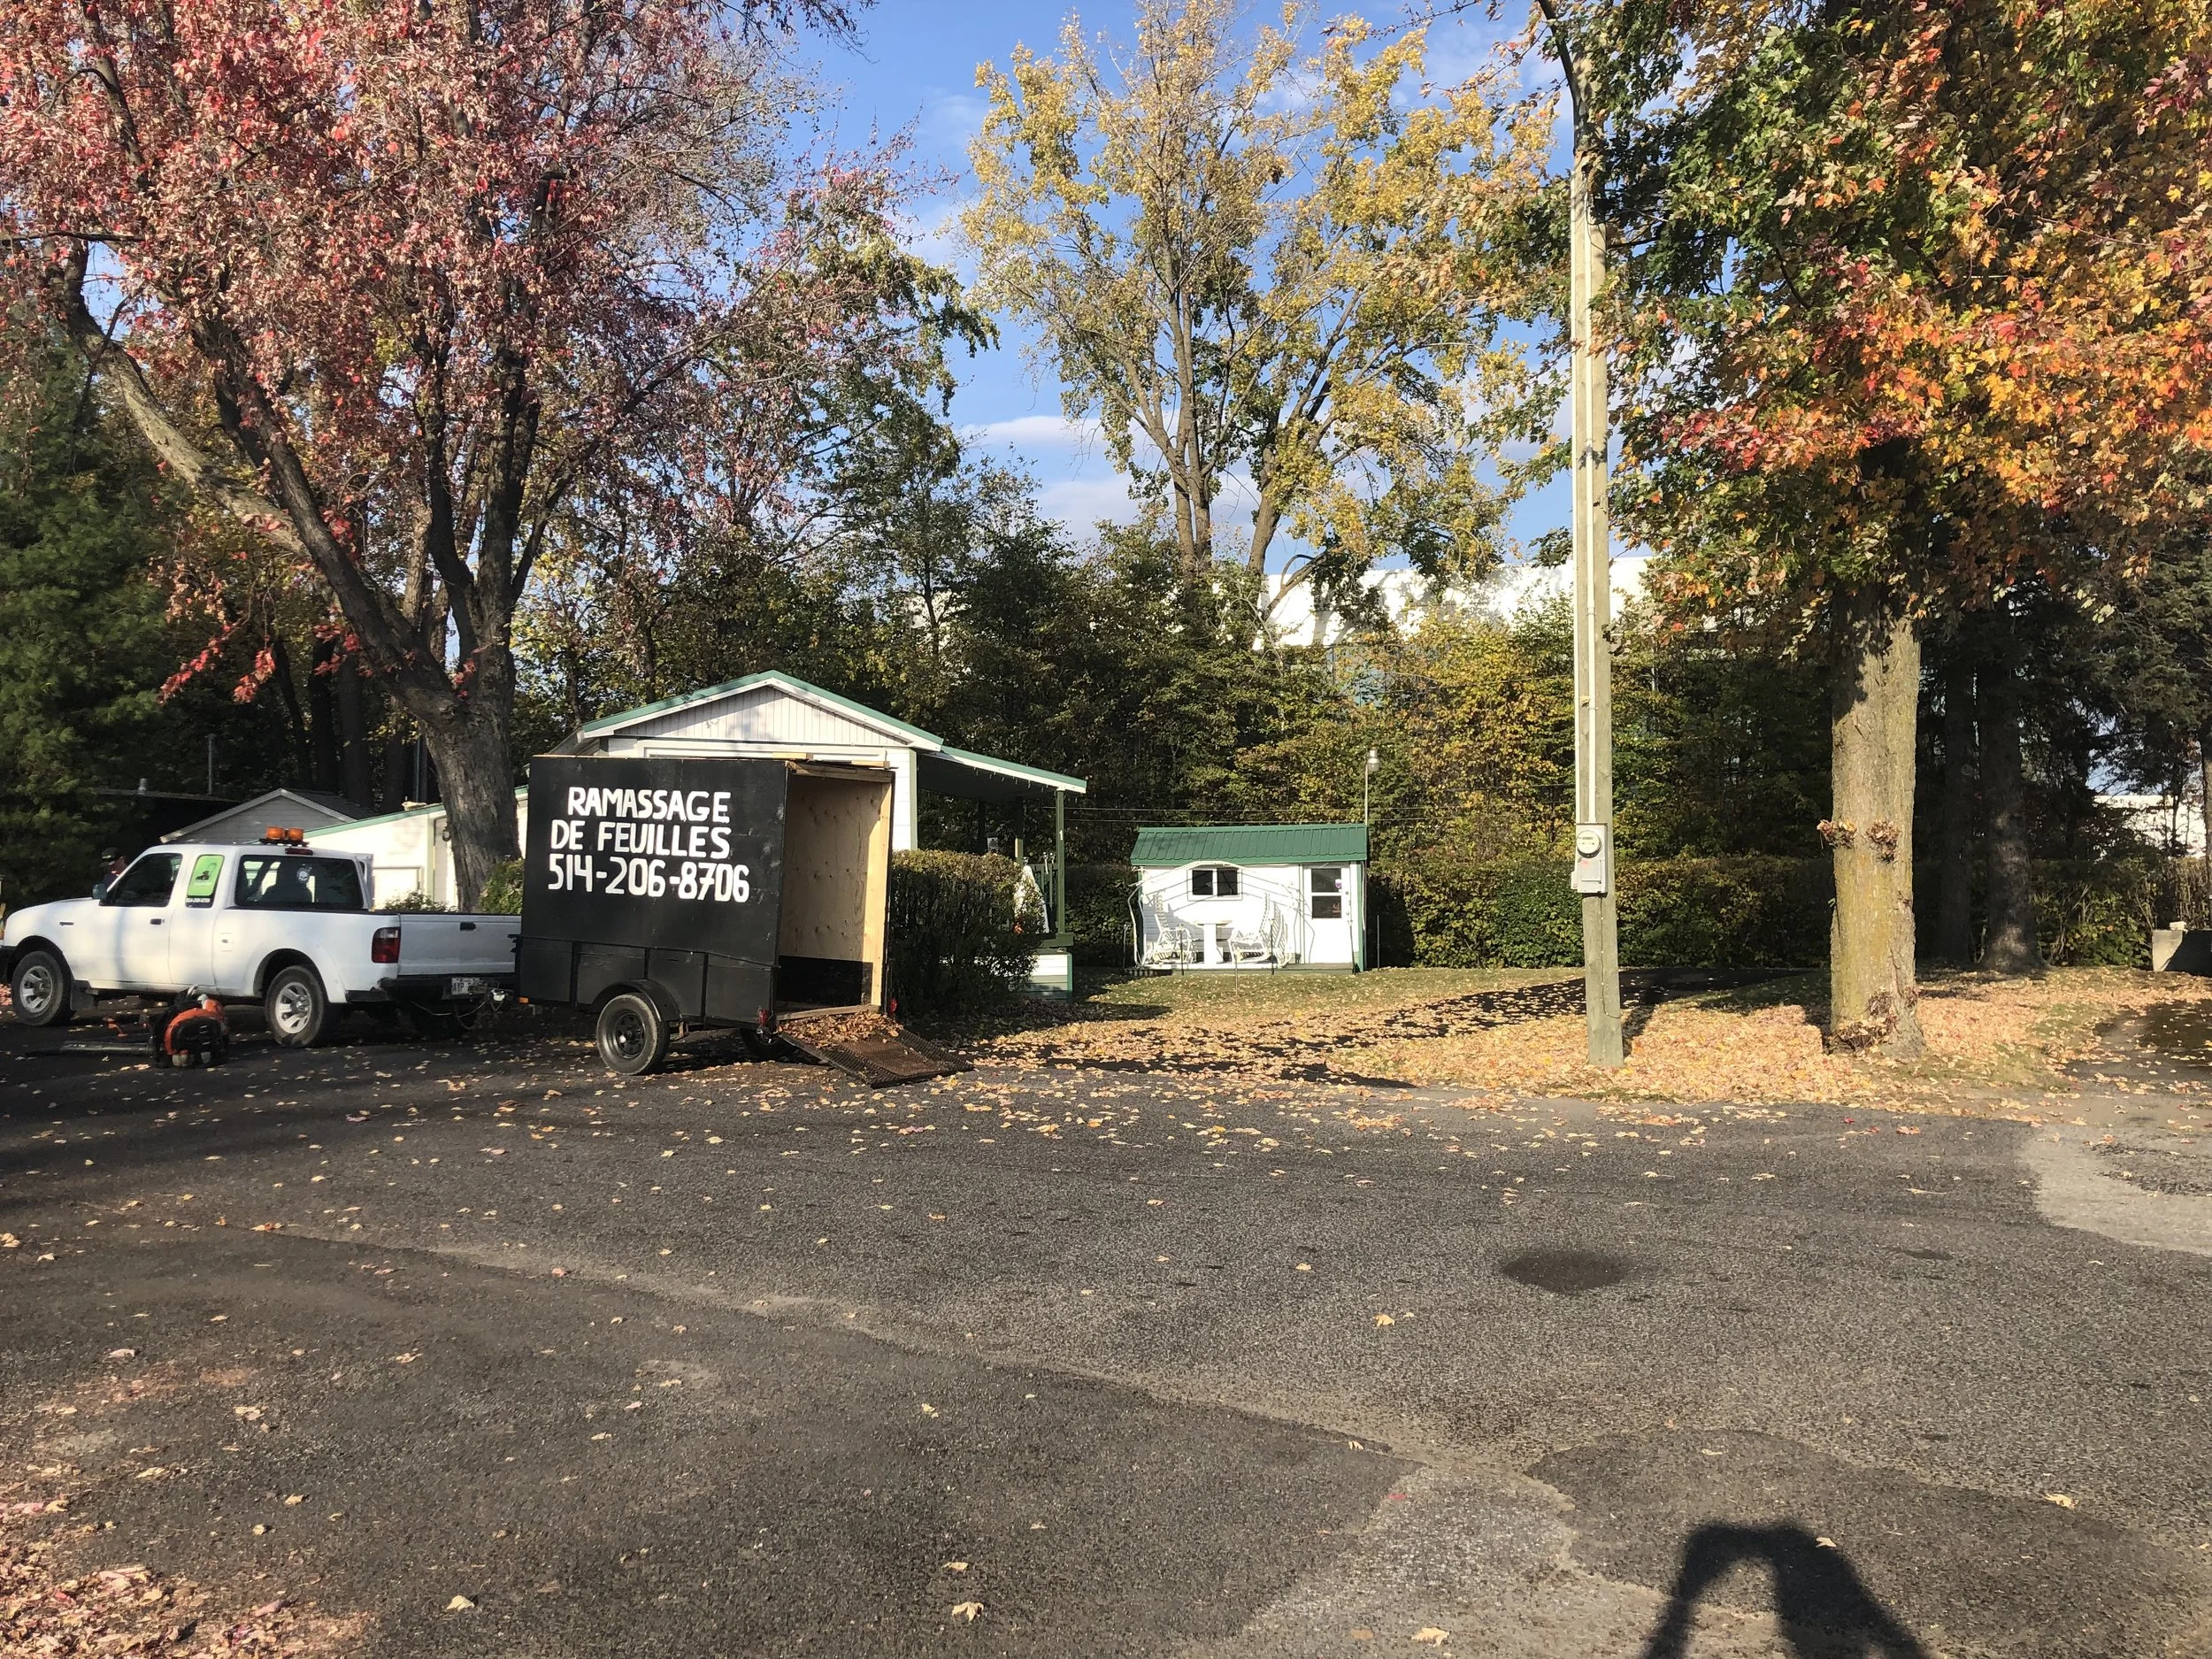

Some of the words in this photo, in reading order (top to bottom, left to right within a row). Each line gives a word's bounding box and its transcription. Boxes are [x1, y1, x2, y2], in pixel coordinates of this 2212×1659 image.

[568, 787, 732, 824] RAMASSAGE
[551, 819, 586, 850] DE
[597, 821, 732, 860] FEUILLES
[548, 853, 750, 902] 514-206-8706
